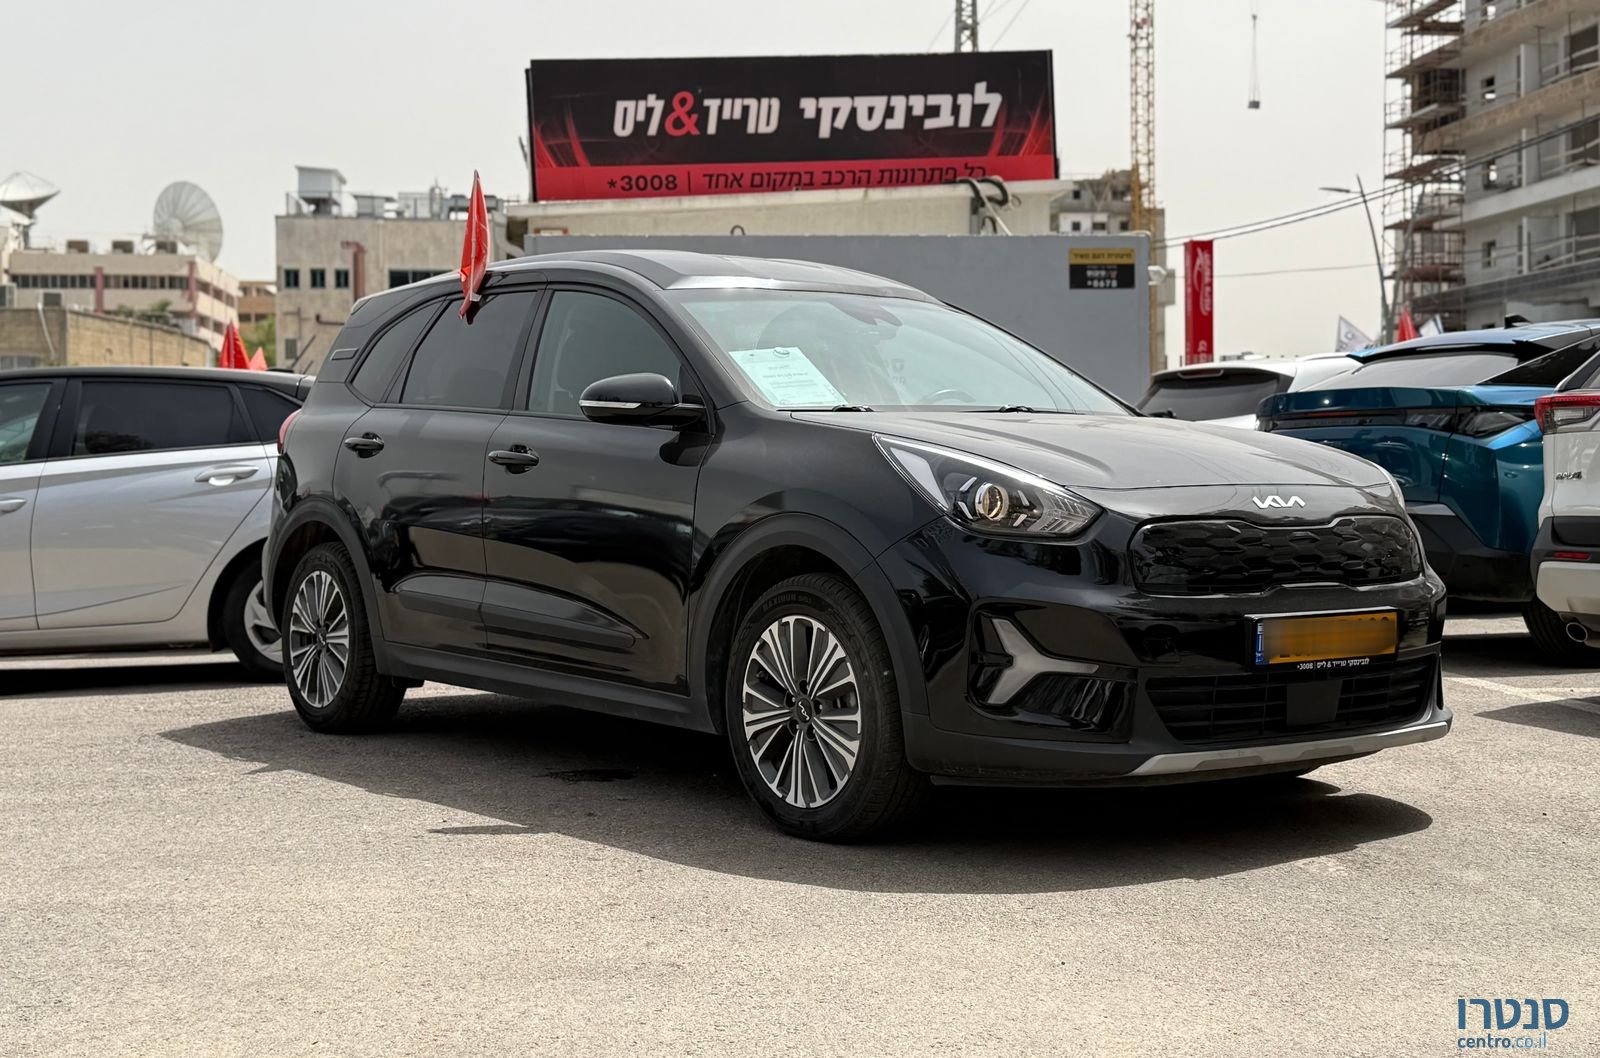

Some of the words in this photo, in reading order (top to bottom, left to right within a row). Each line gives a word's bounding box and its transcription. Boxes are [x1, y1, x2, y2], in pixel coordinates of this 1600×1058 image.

[800, 80, 1002, 139] לובינסקי
[702, 172, 744, 189] אחד
[750, 170, 814, 192] במקום
[820, 169, 872, 187] הרכב
[877, 166, 958, 185] פתרונות
[1252, 495, 1306, 509] KIA
